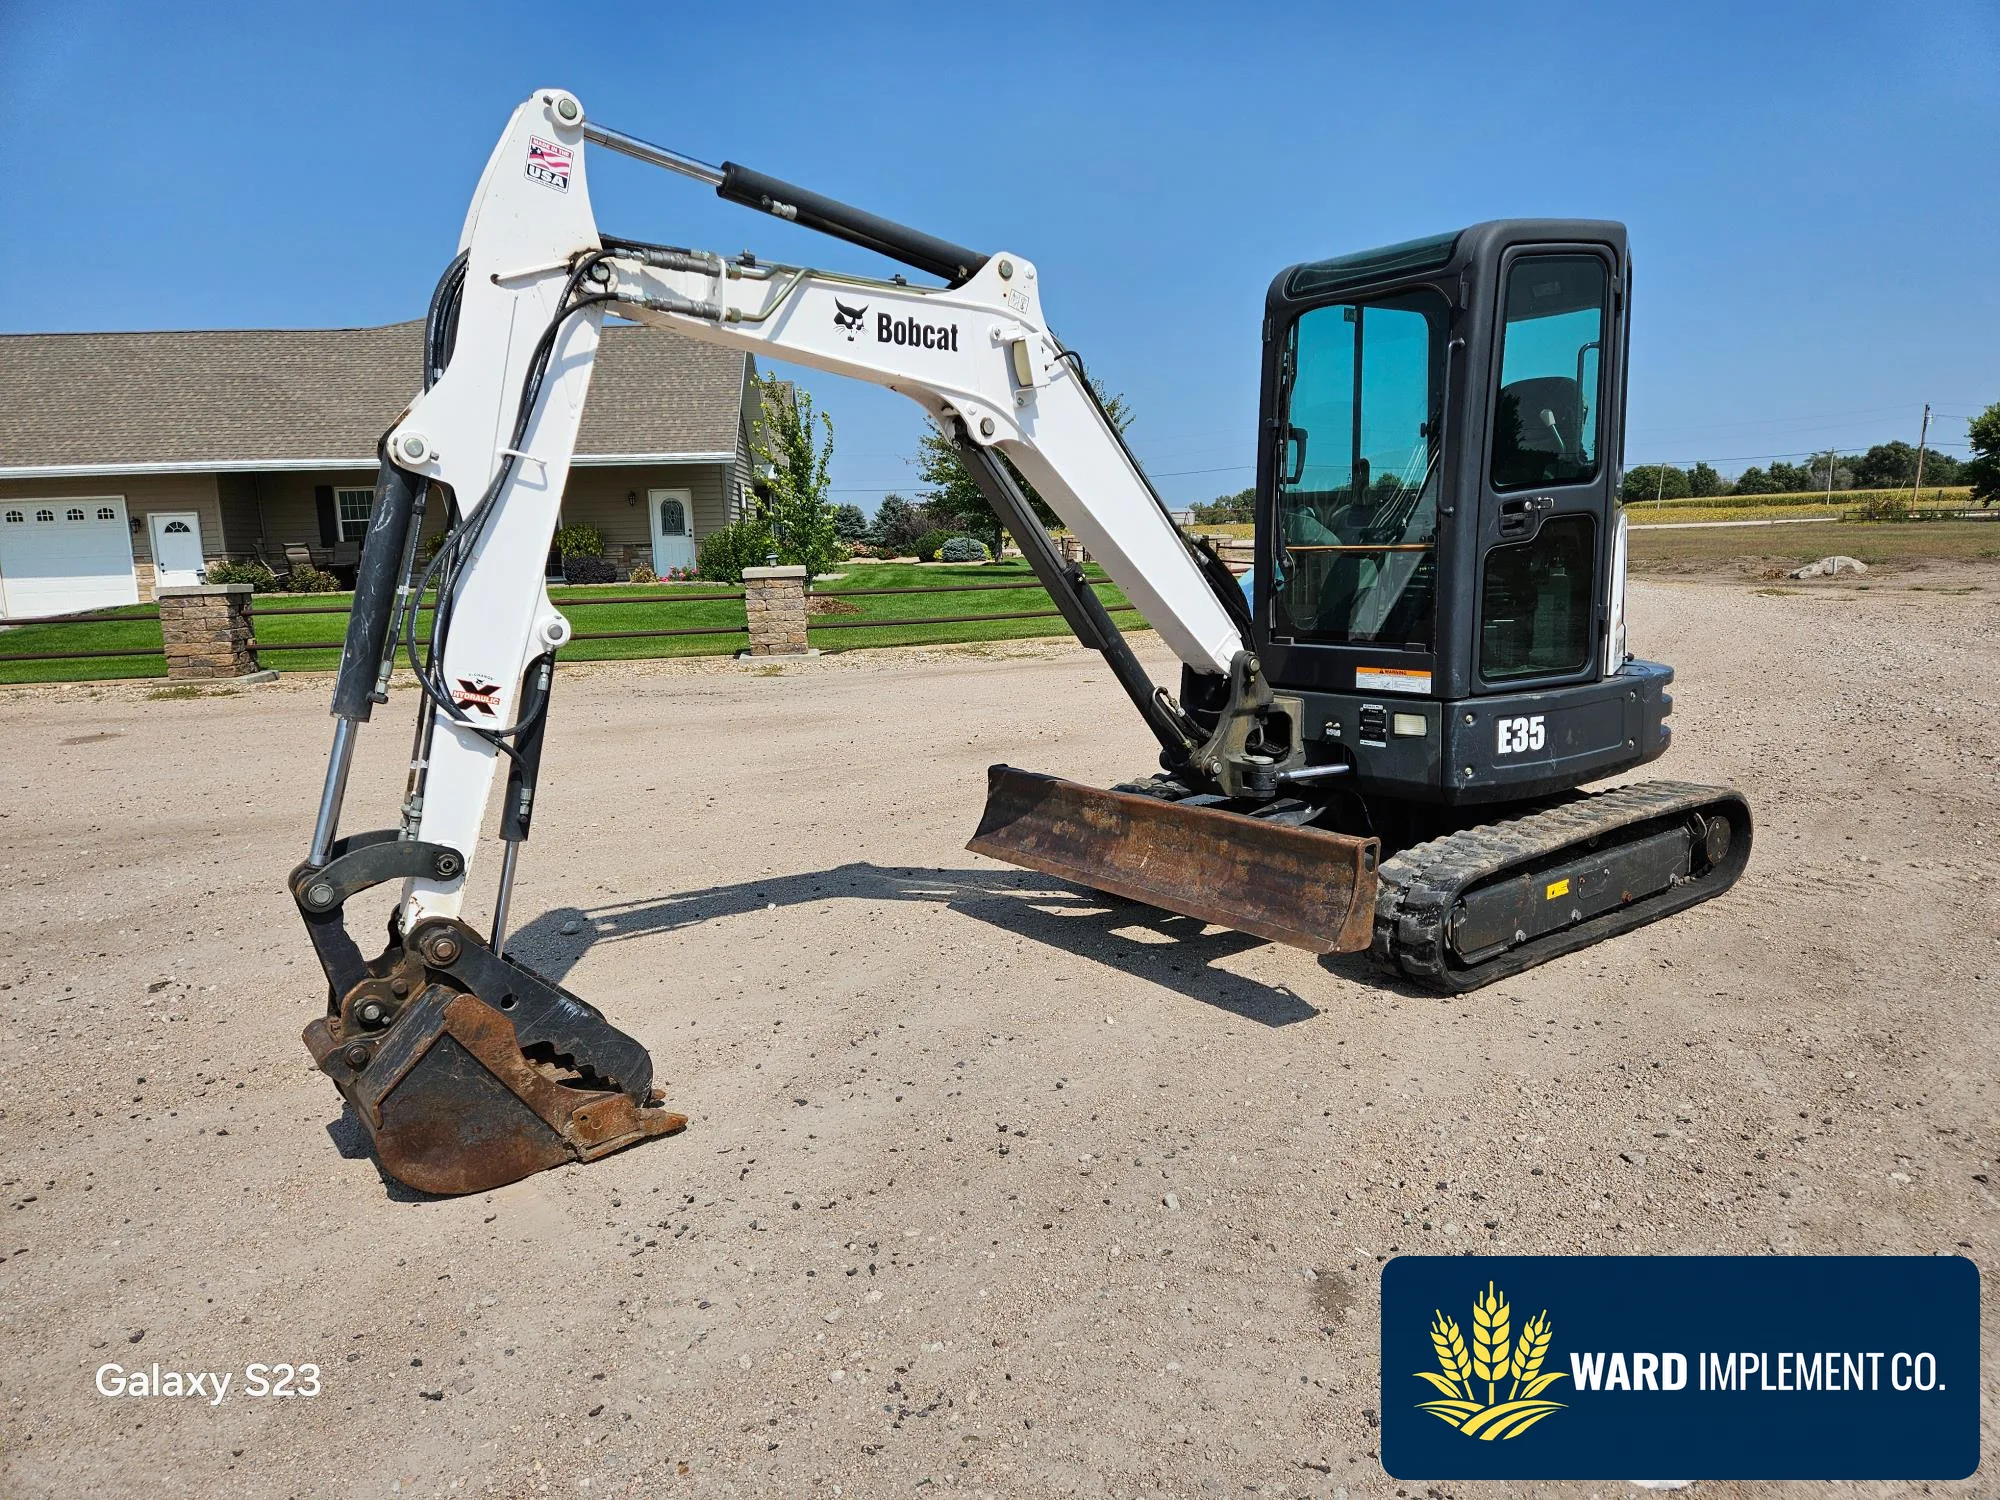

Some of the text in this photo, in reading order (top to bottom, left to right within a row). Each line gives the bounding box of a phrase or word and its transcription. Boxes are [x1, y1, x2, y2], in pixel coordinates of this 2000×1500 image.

[528, 164, 566, 188] USA
[877, 312, 958, 352] Bobcat
[453, 690, 500, 704] HYDRAULIC
[1497, 715, 1545, 754] E35
